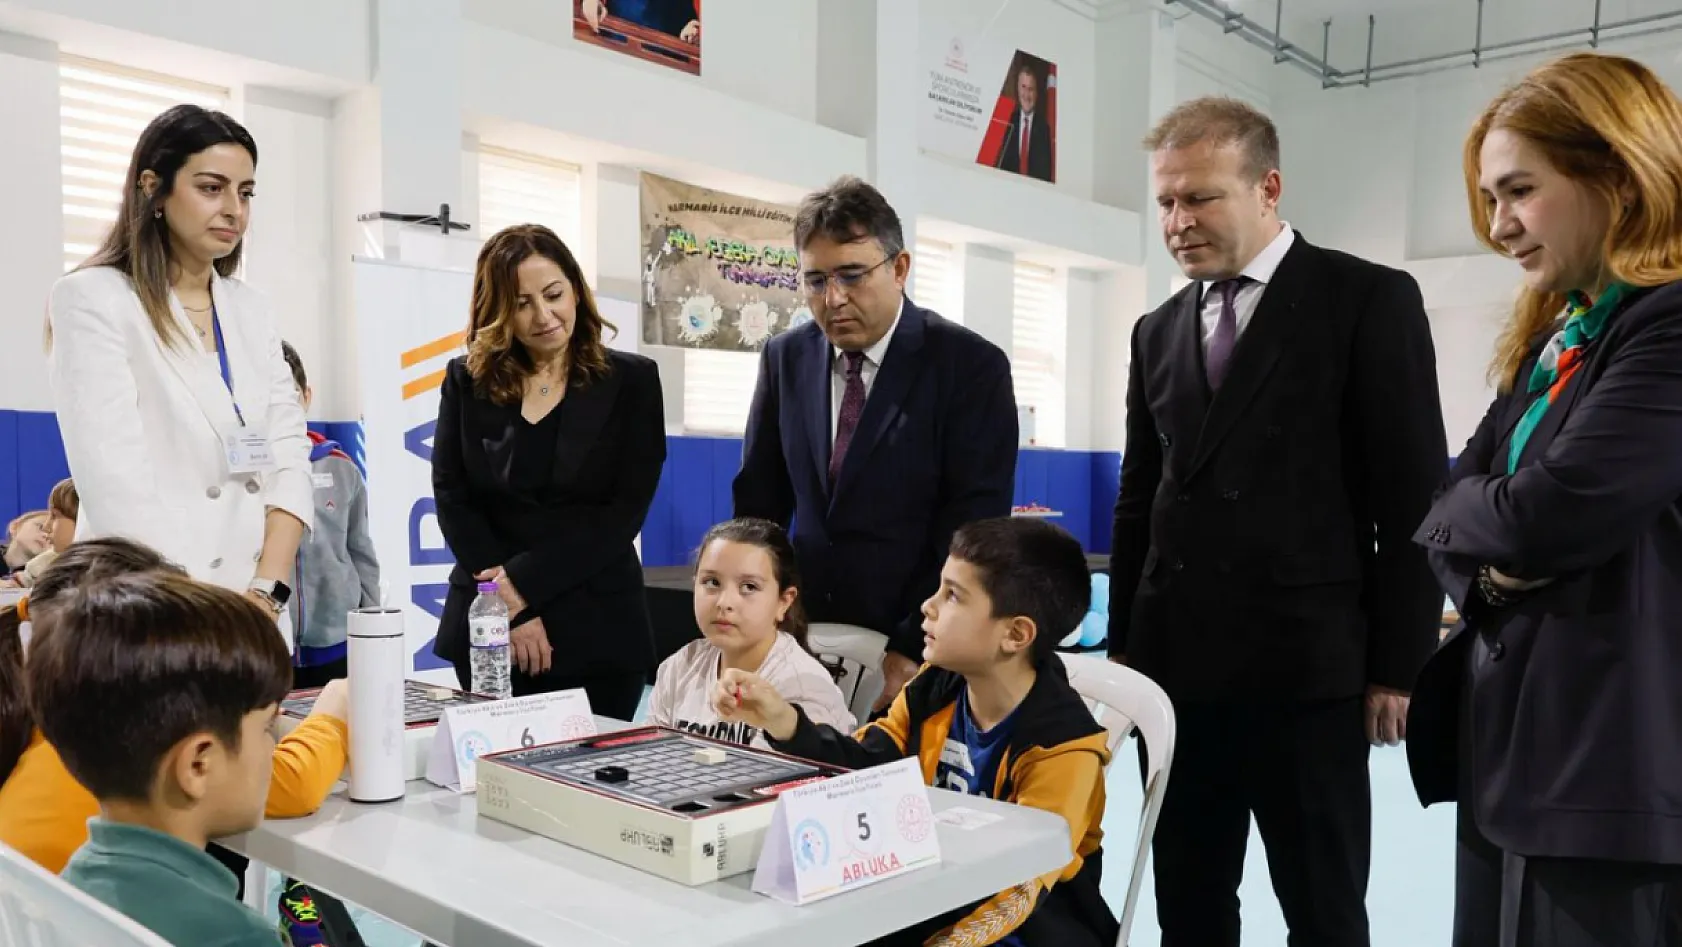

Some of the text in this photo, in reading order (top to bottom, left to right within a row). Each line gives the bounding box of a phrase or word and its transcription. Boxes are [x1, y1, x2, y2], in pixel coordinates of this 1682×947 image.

[521, 727, 536, 748] 6
[857, 812, 871, 841] 5
[843, 853, 901, 882] ABLUKA
